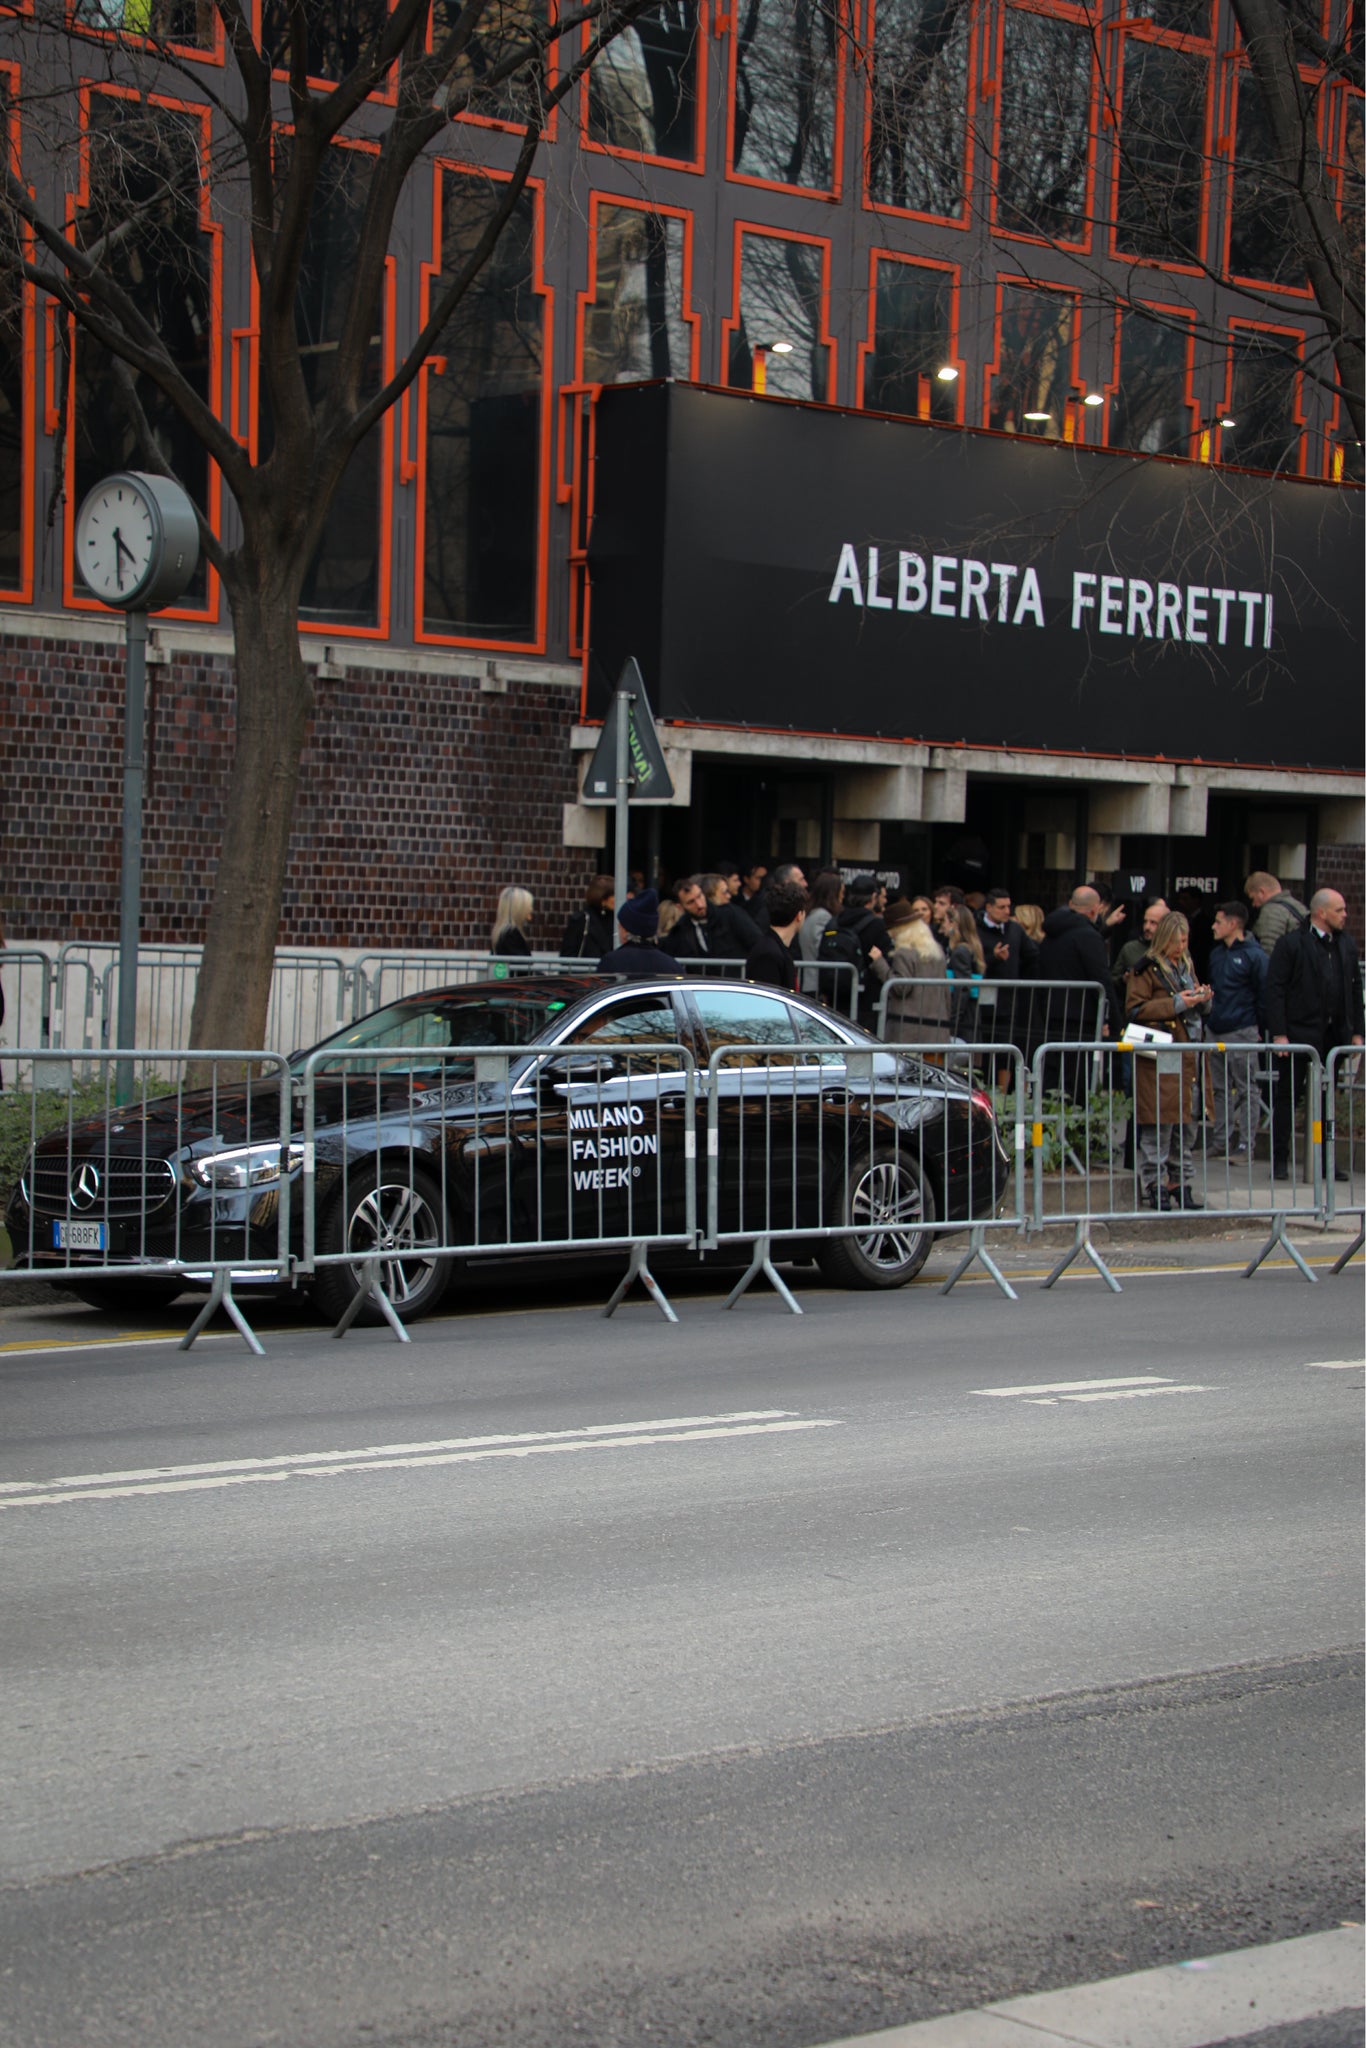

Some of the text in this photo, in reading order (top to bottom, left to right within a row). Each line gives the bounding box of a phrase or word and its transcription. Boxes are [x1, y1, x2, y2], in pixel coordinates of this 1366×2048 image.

[829, 543, 1273, 648] ALBERTA FERRETTI
[1130, 876, 1146, 893] VIP
[568, 1105, 645, 1130] MILANO
[572, 1134, 658, 1160] FASHION
